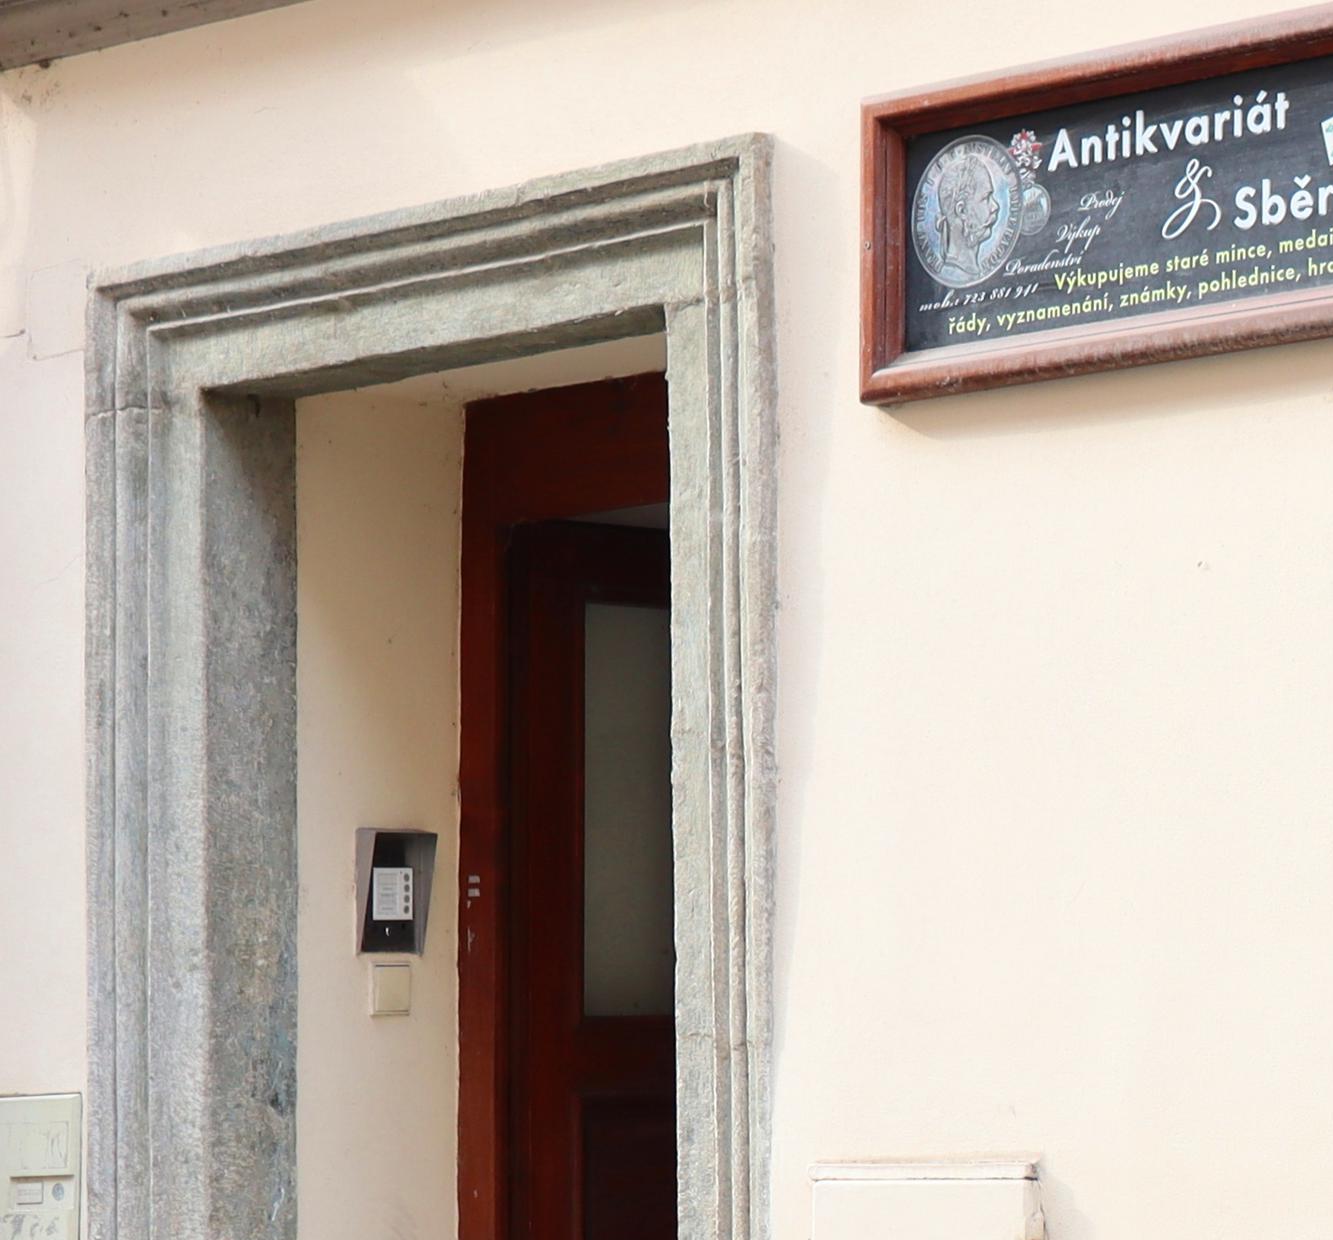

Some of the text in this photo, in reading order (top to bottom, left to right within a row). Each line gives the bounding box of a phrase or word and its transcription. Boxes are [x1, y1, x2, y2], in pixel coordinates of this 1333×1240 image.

[1047, 90, 1290, 172] Antikvariát
[1077, 189, 1125, 220] Prodej
[1161, 158, 1222, 240] &
[1056, 215, 1101, 254] Výkup
[1003, 249, 1085, 277] Poradenství
[1054, 261, 1160, 294] Výkupujeme
[1165, 249, 1209, 272] staré
[1216, 244, 1273, 264] mince,
[948, 312, 991, 335] řády,
[997, 293, 1114, 331] vyznamenání,
[1119, 281, 1193, 308] známky,
[1198, 266, 1302, 299] pohlednice,
[963, 291, 986, 306] 723
[989, 286, 1012, 300] 881
